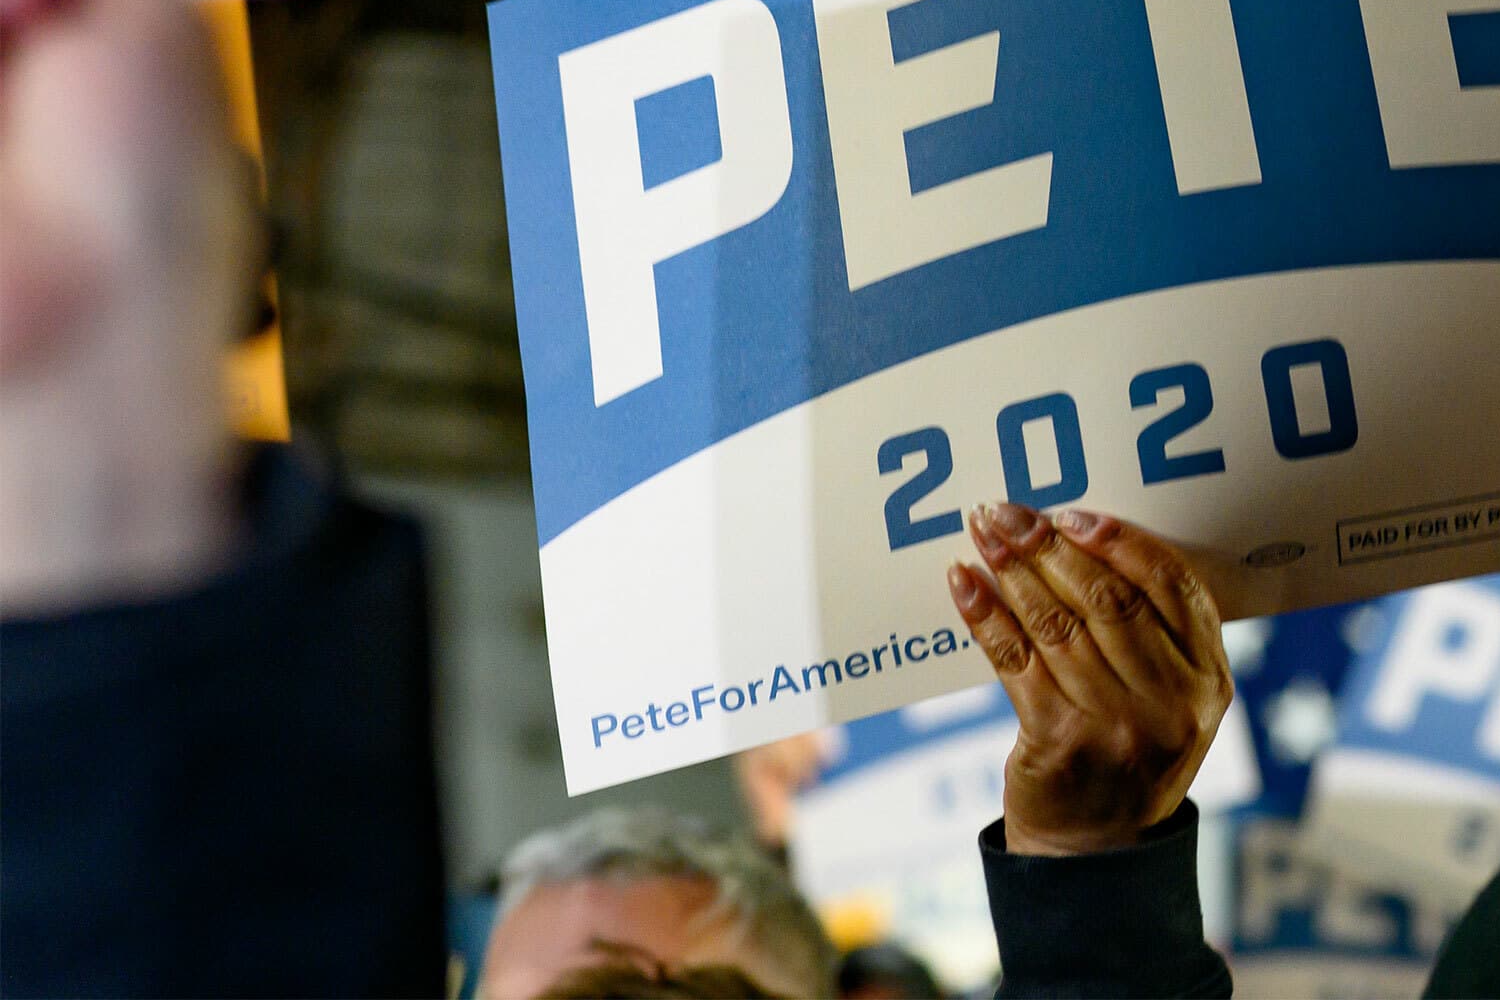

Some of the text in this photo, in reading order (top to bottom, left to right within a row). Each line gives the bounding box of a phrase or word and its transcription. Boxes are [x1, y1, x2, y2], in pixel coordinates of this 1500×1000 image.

[876, 336, 1359, 553] 2020
[1348, 525, 1399, 553] PAID
[1405, 517, 1449, 542] FOR
[1455, 511, 1481, 535] BY
[590, 626, 980, 749] PeteForAmerica.
